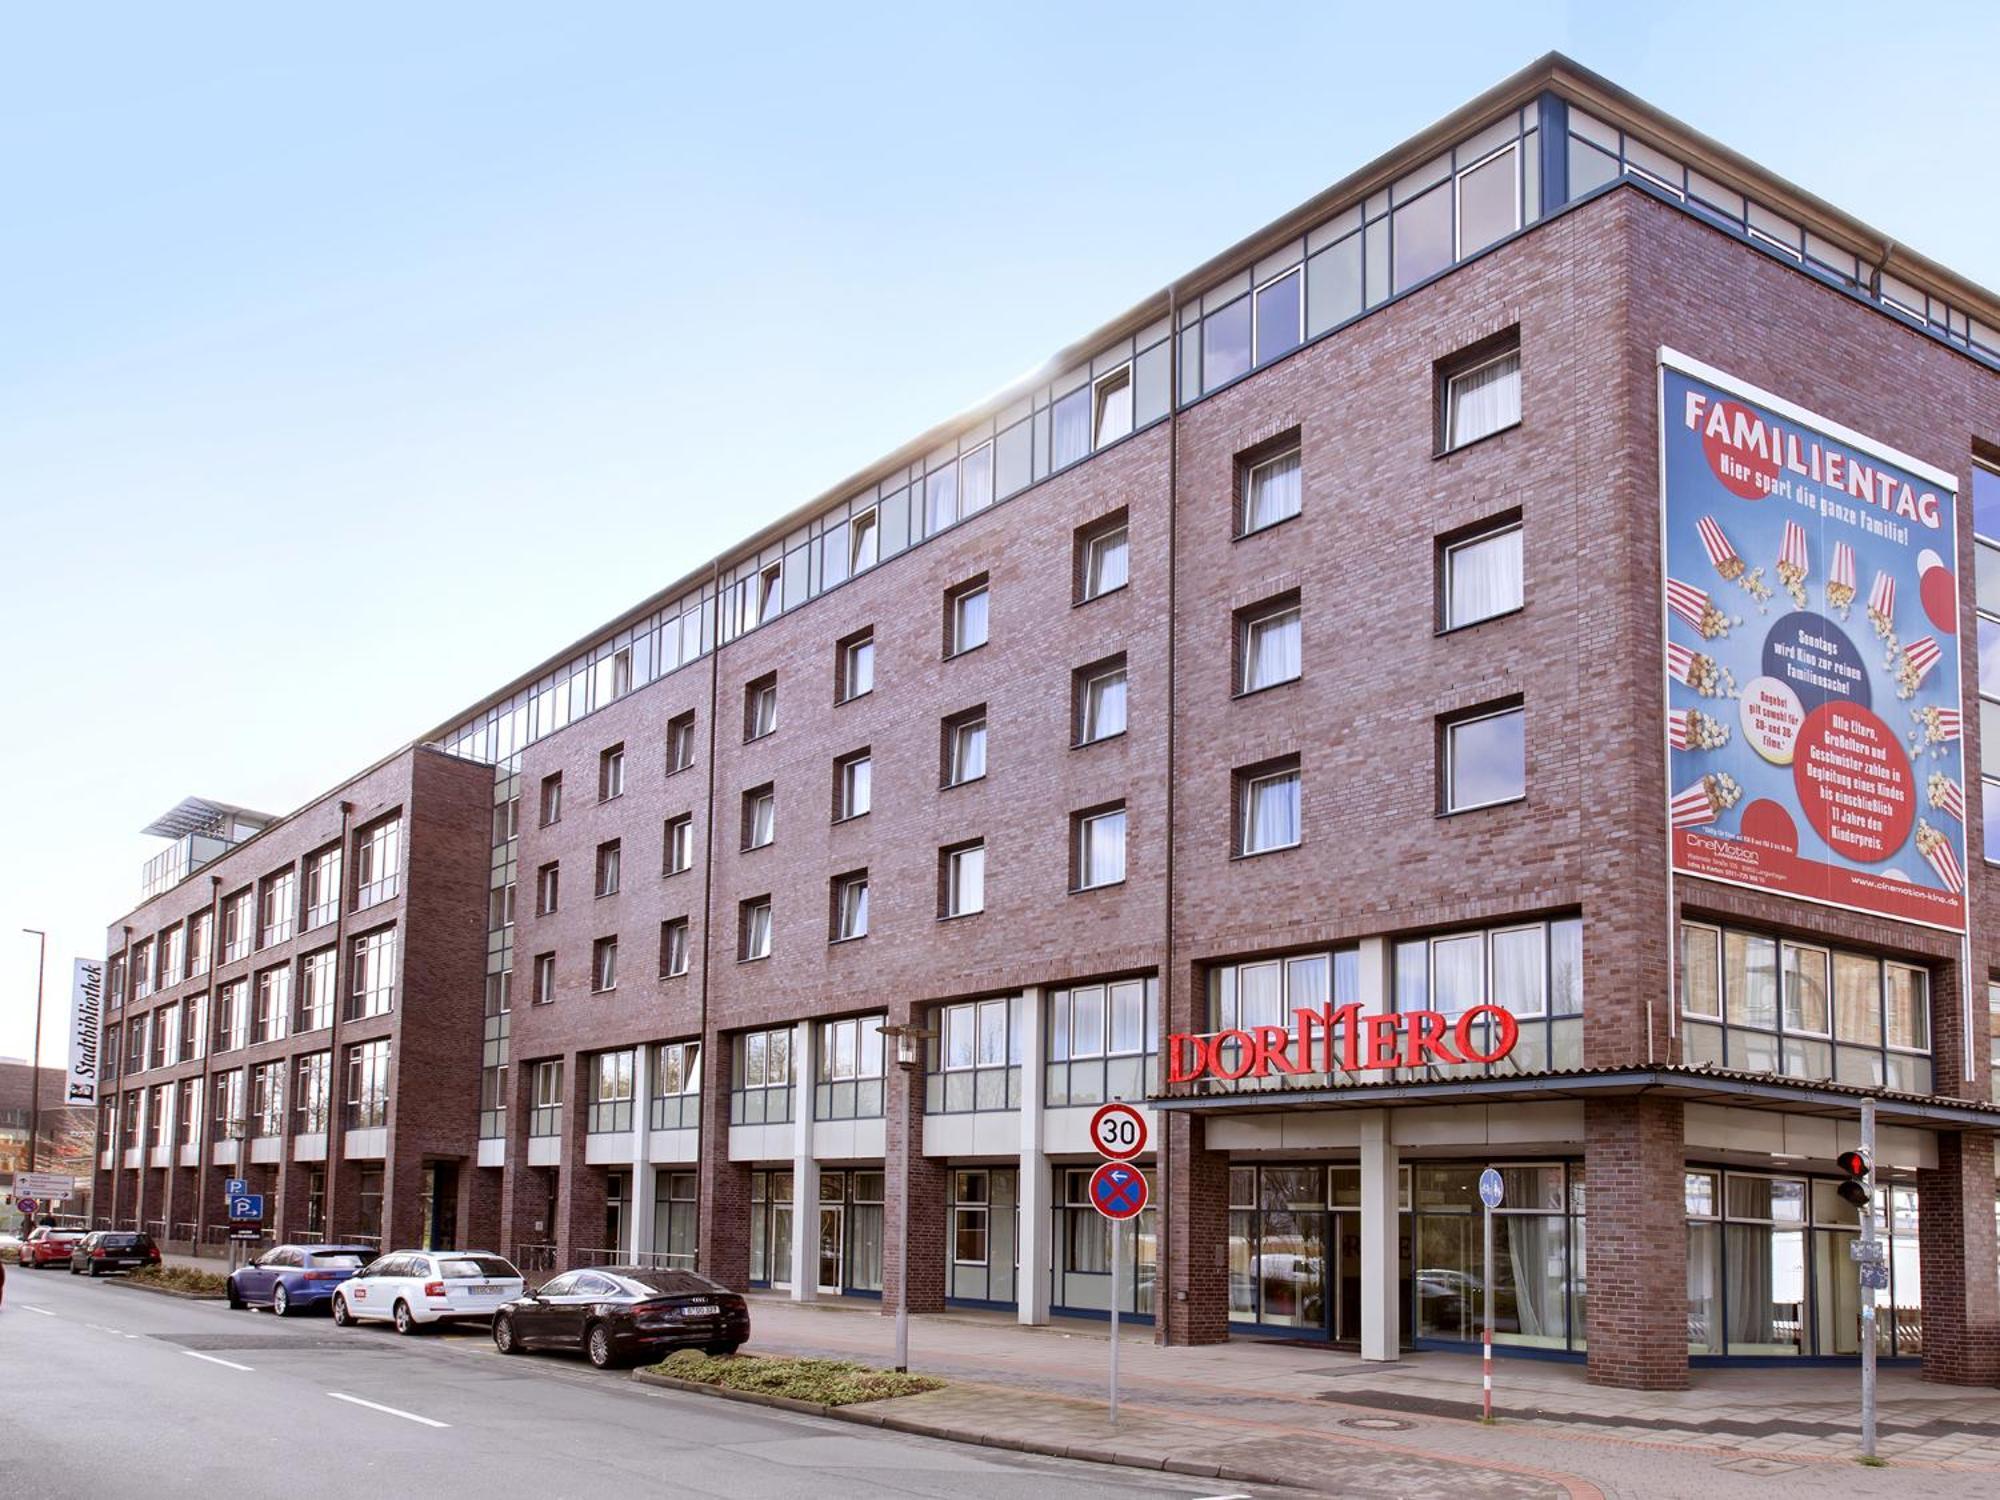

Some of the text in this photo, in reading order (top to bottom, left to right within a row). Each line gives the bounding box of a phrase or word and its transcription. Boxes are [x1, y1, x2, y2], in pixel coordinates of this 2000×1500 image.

[1685, 391, 1940, 529] FAMILIENTAG
[1720, 453, 1908, 546] Hier spart die ganze Familie!
[1798, 629, 1838, 656] Sonntags
[1774, 642, 1862, 681] wird Kino zur reinen
[1787, 663, 1850, 695] Familiensache!
[1832, 714, 1878, 741] Alle Eltern,
[1824, 730, 1886, 760] Großeltern und
[1810, 745, 1901, 782] Geschwister zahlen in
[1807, 762, 1904, 801] Begleitung eines Kindes
[1820, 785, 1893, 817] bis einschließlich
[1832, 806, 1882, 832] 11 Jahre den
[1686, 834, 1759, 860] CineMotion
[1831, 825, 1883, 850] Kinderpreis.
[1851, 877, 1959, 906] www.cinemotion-kino.de
[75, 964, 101, 1079] Stadtbibliothek
[1102, 1118, 1136, 1146] 30
[230, 1181, 243, 1193] P
[236, 1202, 250, 1216] P
